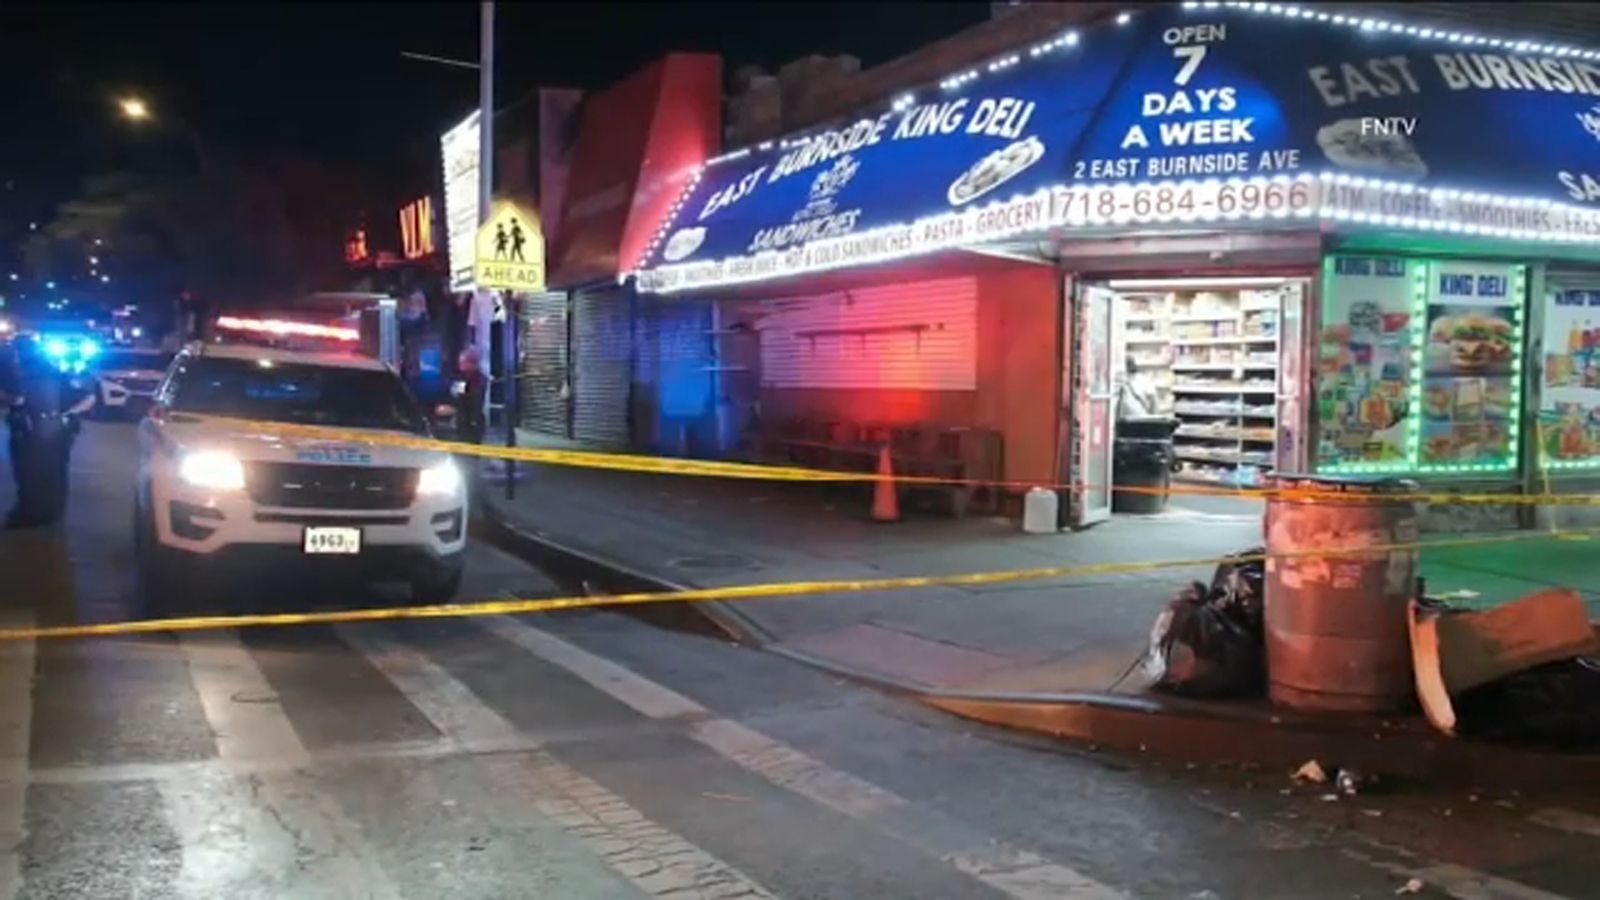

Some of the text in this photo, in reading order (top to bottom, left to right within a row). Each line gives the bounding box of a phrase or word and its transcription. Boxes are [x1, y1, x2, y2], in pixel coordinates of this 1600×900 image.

[1163, 24, 1226, 45] OPEN
[1173, 45, 1206, 86] 7
[1309, 55, 1420, 107] EAST
[1142, 87, 1237, 117] DAYS
[1120, 118, 1255, 150] A WEEK
[698, 166, 766, 220] EAST
[767, 114, 892, 184] BURNSIDE
[893, 96, 971, 142] KING
[965, 96, 1036, 139] DELI
[1073, 149, 1301, 179] 2 EAST BURNSIDE AVE
[1059, 182, 1310, 219] 718-684-6966
[1326, 184, 1365, 210] ATM
[1379, 191, 1442, 218] COFFEE
[1457, 202, 1552, 232] SMOOTHIES
[748, 208, 861, 251] SANDWICHES
[839, 229, 913, 262] SANDWICHES
[923, 218, 966, 243] PASTA
[976, 199, 1045, 234] GROCERY
[481, 264, 538, 283] AHEAD
[1440, 273, 1507, 297] KING DELI
